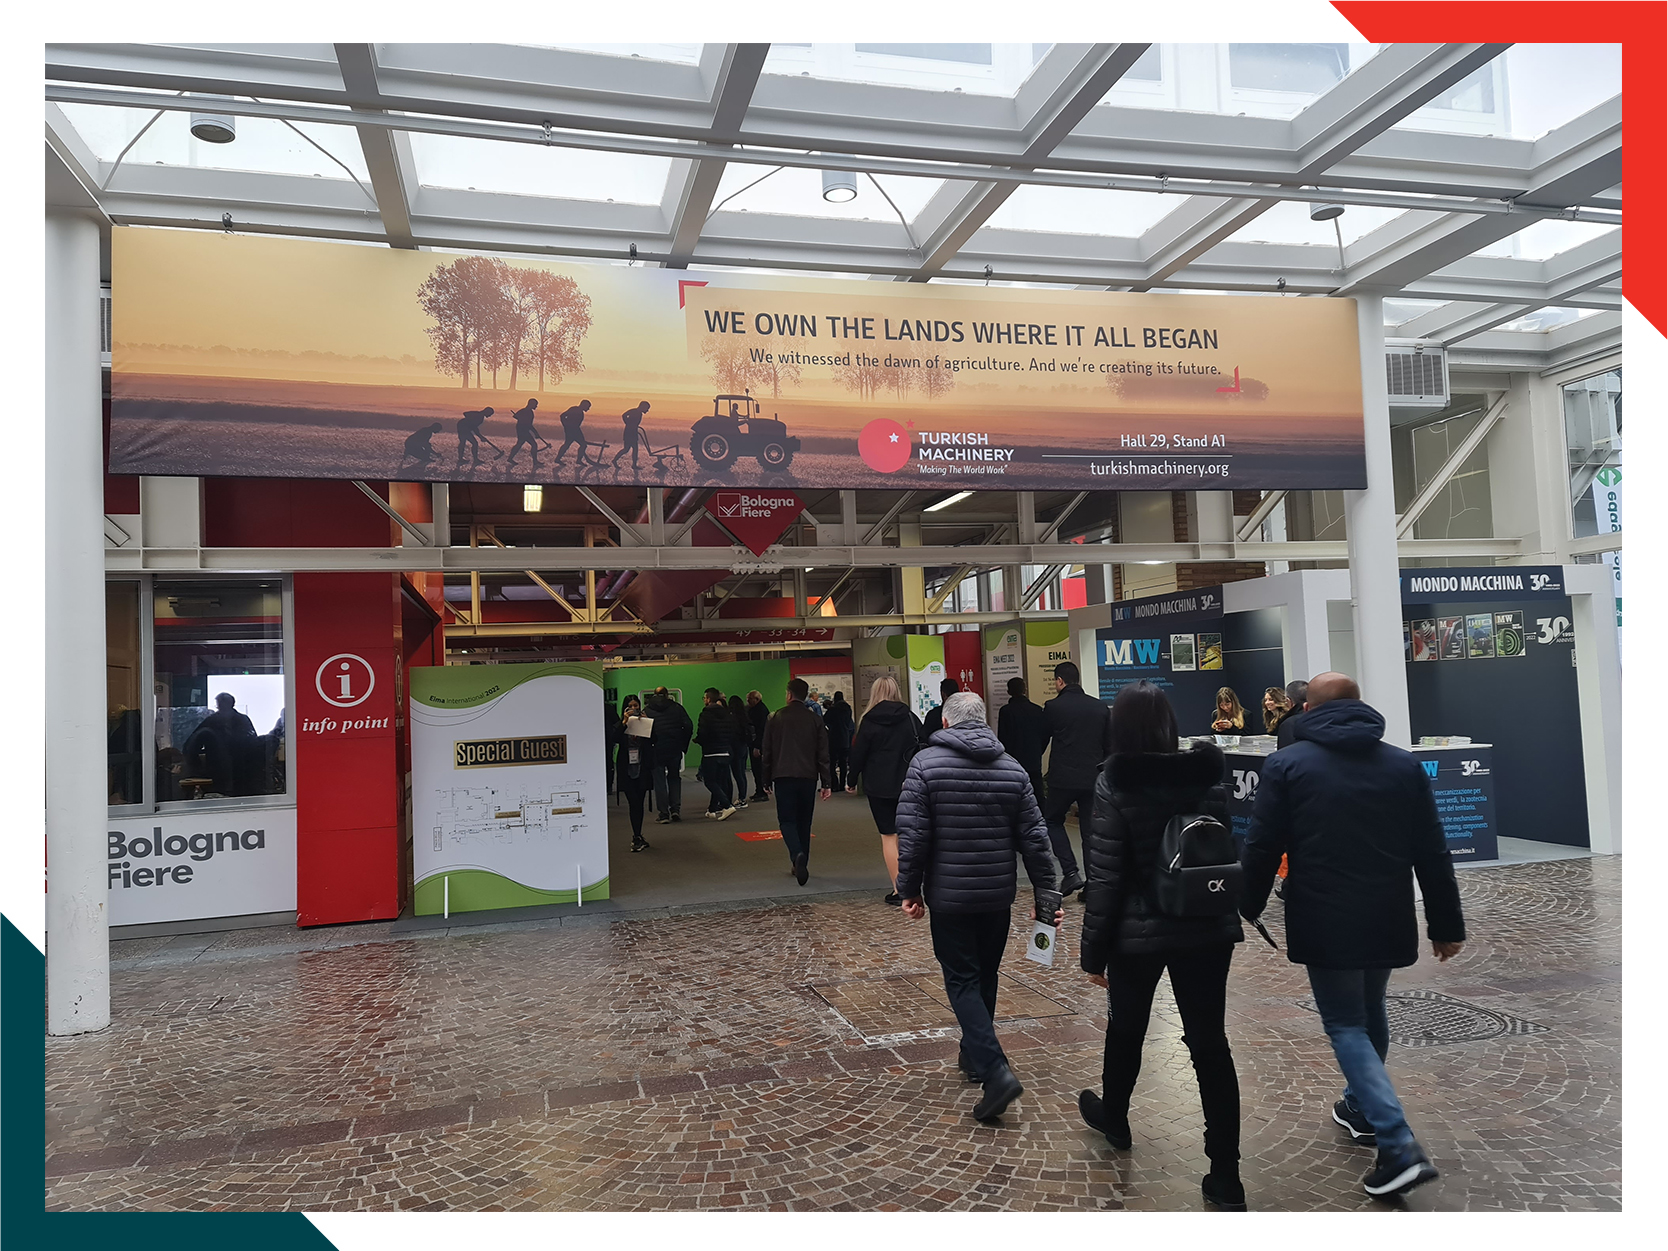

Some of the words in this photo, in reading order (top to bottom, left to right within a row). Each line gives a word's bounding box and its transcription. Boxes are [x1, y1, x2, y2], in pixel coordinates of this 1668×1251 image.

[704, 309, 746, 335] WE
[755, 312, 817, 337] OWN
[826, 315, 876, 340] THE
[884, 318, 964, 343] LANDS
[972, 321, 1058, 345] WHERE
[1065, 325, 1085, 346] IT
[1094, 326, 1136, 348] ALL
[1143, 327, 1219, 349] BEGAN
[750, 348, 773, 363] We
[778, 350, 851, 366] witnessed
[856, 353, 879, 367] the
[884, 354, 920, 368] dawn
[925, 355, 940, 369] of
[944, 356, 1025, 372] agriculture.
[1029, 357, 1056, 372] And
[1060, 357, 1095, 373] we're
[1099, 360, 1153, 377] creating
[1157, 361, 1174, 375] its
[1177, 361, 1222, 375] future.
[919, 432, 988, 445] TURKISH
[1120, 434, 1146, 448] Hall
[1149, 434, 1170, 449] 29,
[1173, 434, 1208, 448] Stand
[1211, 434, 1226, 448] A1
[919, 448, 1014, 461] MACHINERY
[949, 465, 962, 474] The
[964, 465, 985, 474] World
[1090, 460, 1230, 477] turkishmachinery.org
[741, 494, 795, 509] Bologna
[742, 507, 771, 518] Fiere
[1411, 576, 1459, 593] MONDO
[1461, 575, 1524, 592] MACCHINA
[1115, 606, 1132, 621] MW
[1135, 603, 1160, 618] MONDO
[1160, 597, 1197, 615] MACCHINA
[1048, 651, 1067, 661] EIMA
[1104, 639, 1161, 665] MW
[484, 685, 500, 698] 2022
[302, 717, 337, 735] info
[341, 716, 389, 734] point
[457, 740, 515, 766] Special
[520, 737, 565, 760] Guest
[1421, 760, 1439, 777] W
[108, 826, 265, 862] Bologna
[108, 861, 194, 890] Fiere
[1207, 879, 1226, 892] CK
